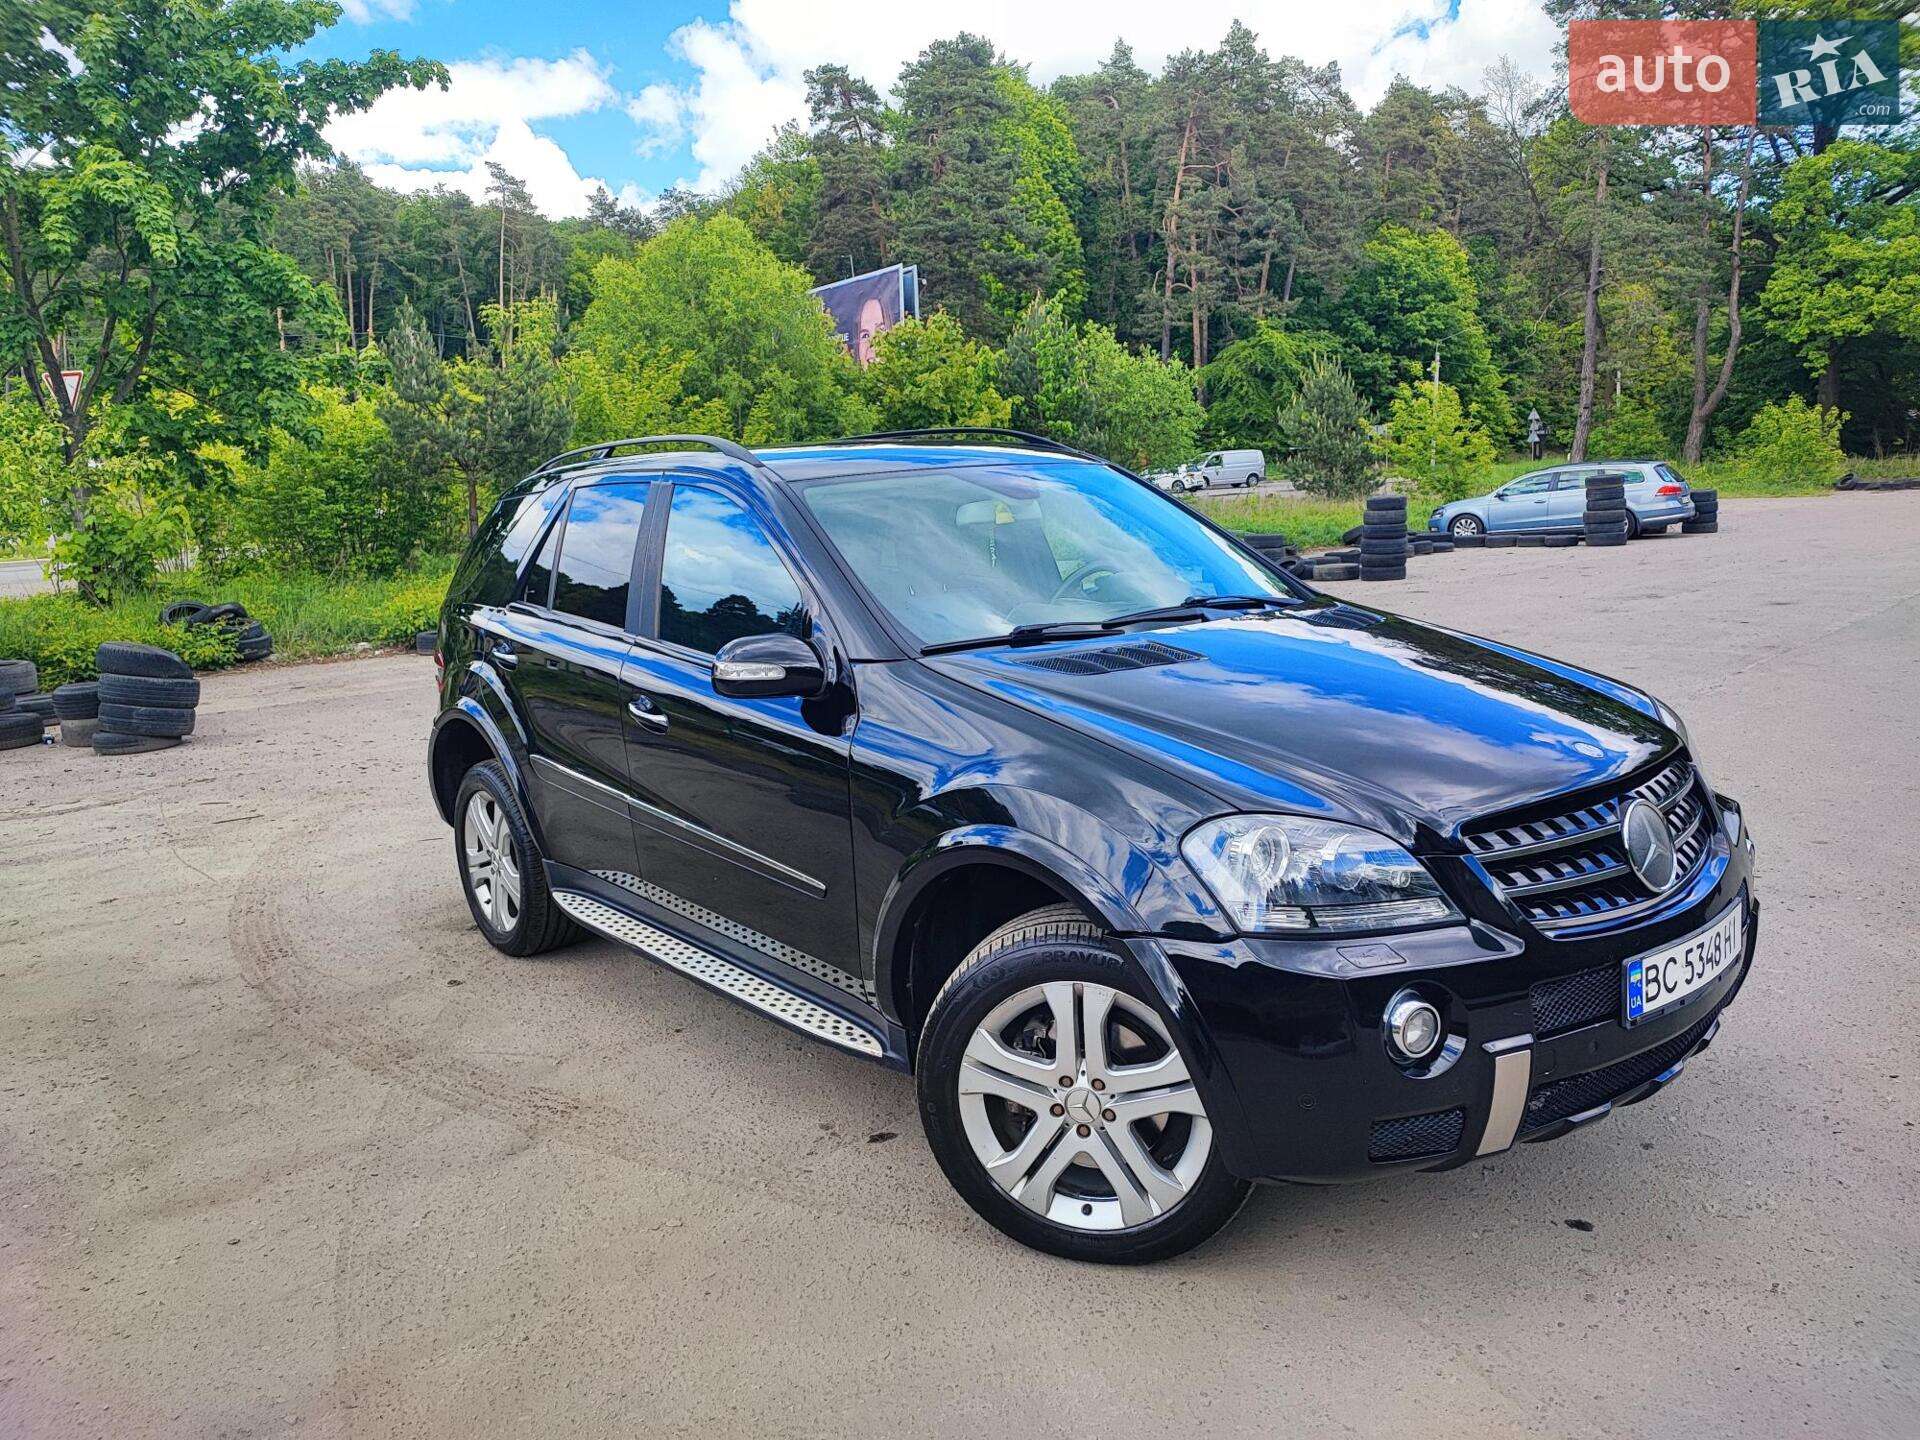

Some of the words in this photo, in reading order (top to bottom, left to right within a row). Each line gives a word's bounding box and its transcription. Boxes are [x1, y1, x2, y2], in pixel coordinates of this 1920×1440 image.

[1645, 956, 1678, 1003] BC
[1684, 931, 1721, 985] 5348
[1724, 916, 1736, 958] HI
[1631, 998, 1642, 1009] UA
